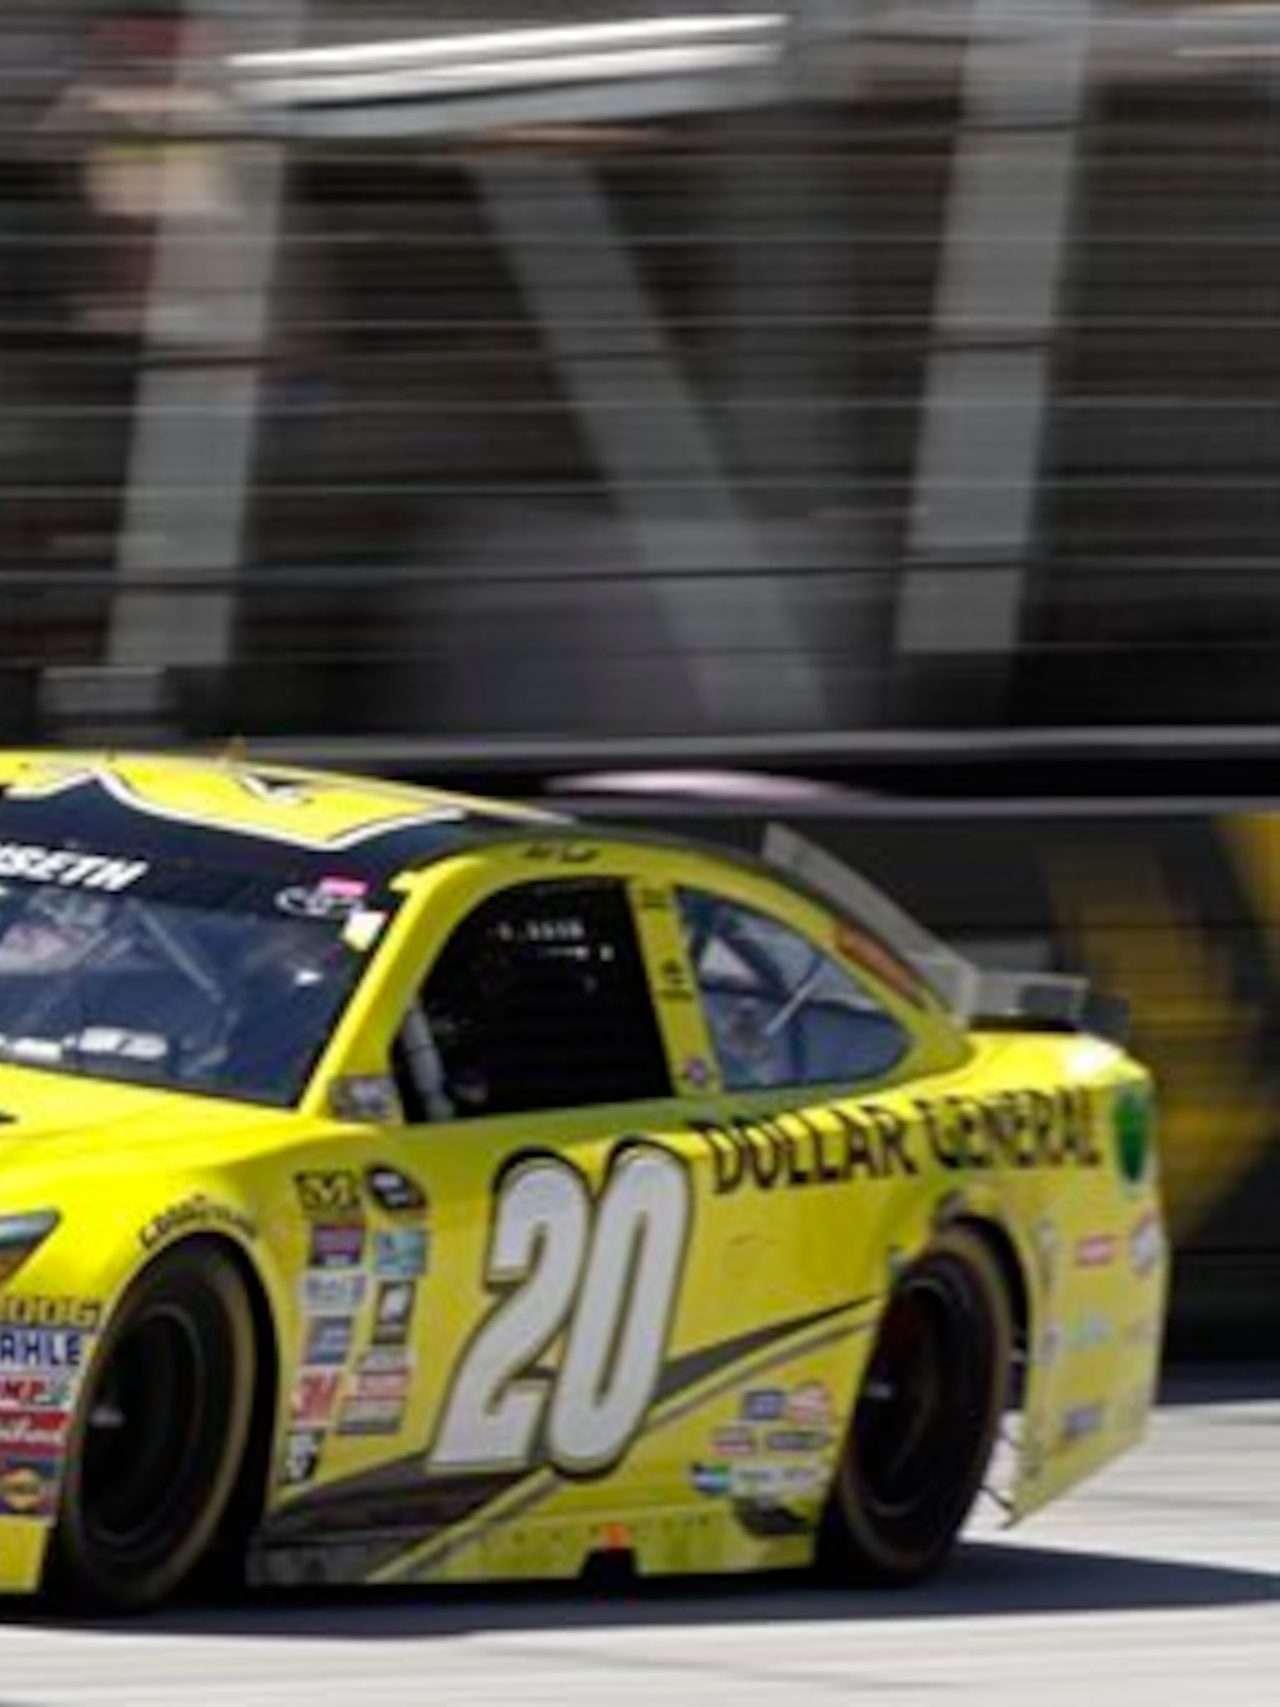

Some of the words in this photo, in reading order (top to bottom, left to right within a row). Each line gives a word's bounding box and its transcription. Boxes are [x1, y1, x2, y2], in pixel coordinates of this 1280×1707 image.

[690, 1103, 917, 1195] DOLLAR
[914, 1086, 1102, 1169] GENERAL
[420, 1134, 694, 1482] 20
